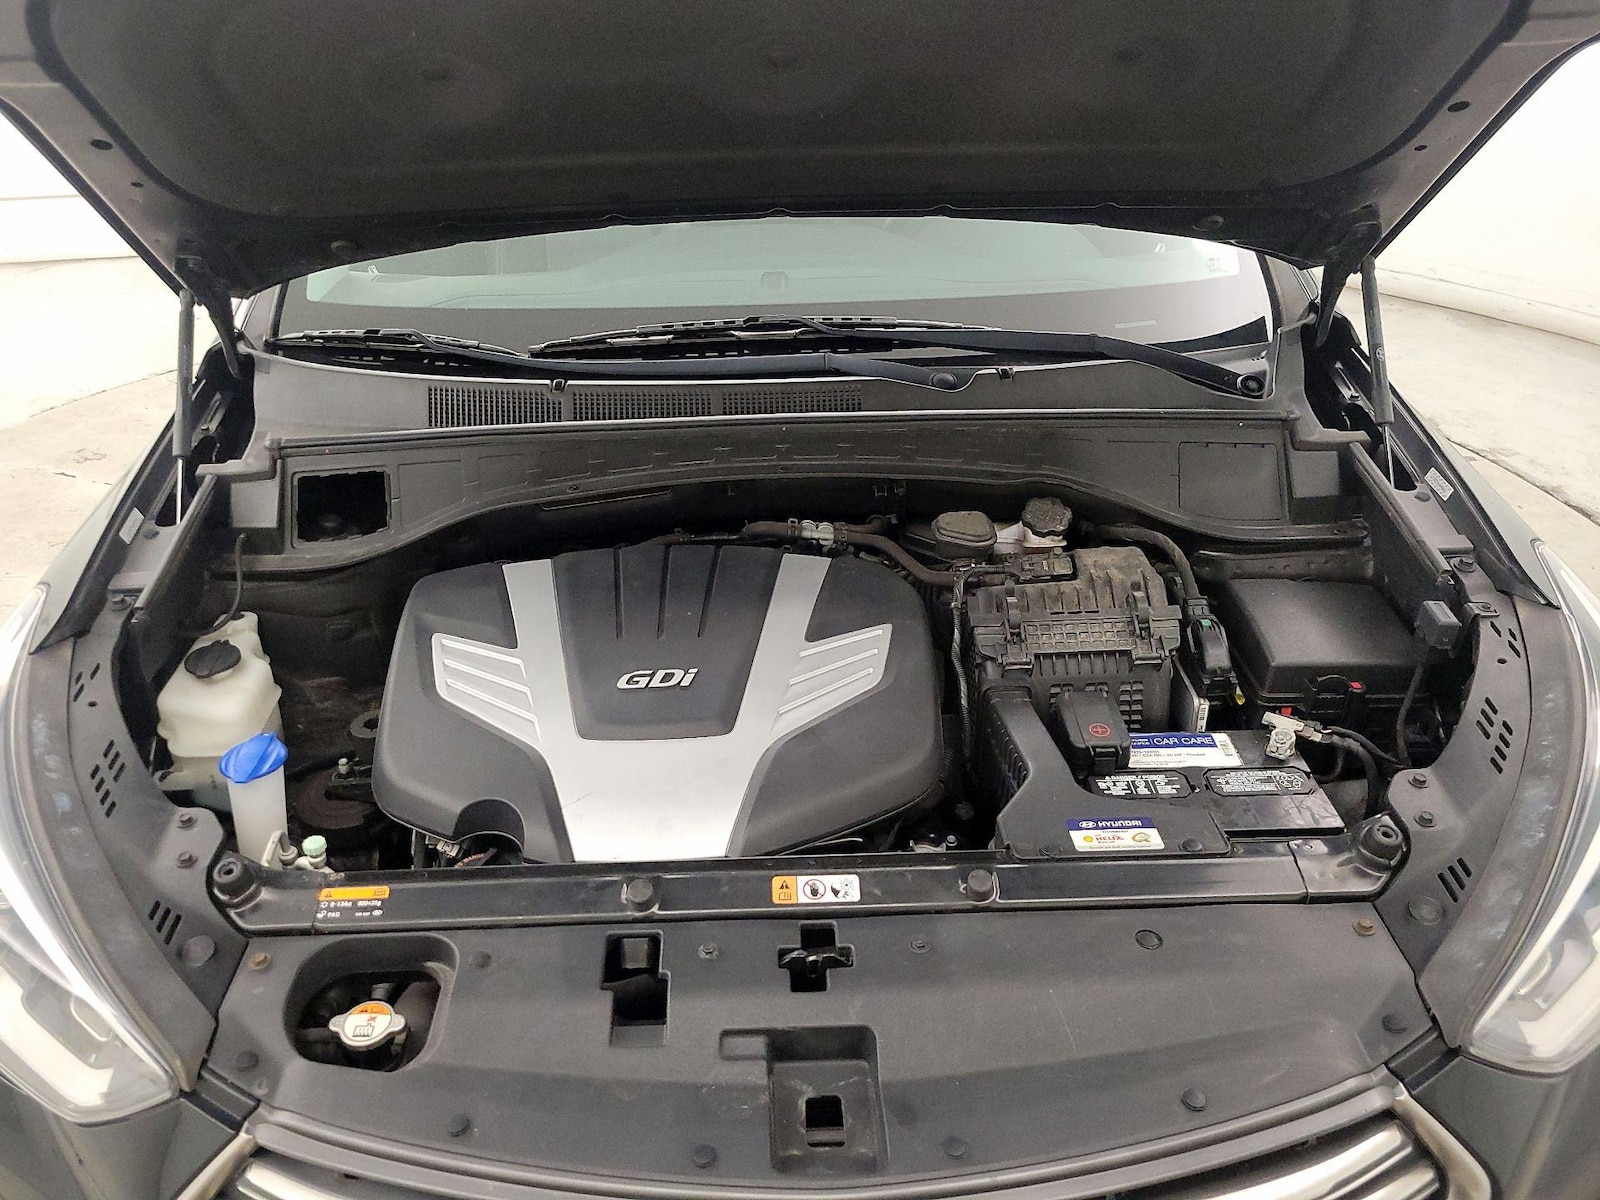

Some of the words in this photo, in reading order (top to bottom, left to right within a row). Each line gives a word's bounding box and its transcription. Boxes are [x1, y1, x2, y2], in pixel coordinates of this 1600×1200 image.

[616, 668, 699, 689] GDi
[1154, 737, 1179, 745] CAR
[1181, 737, 1214, 745] CARE
